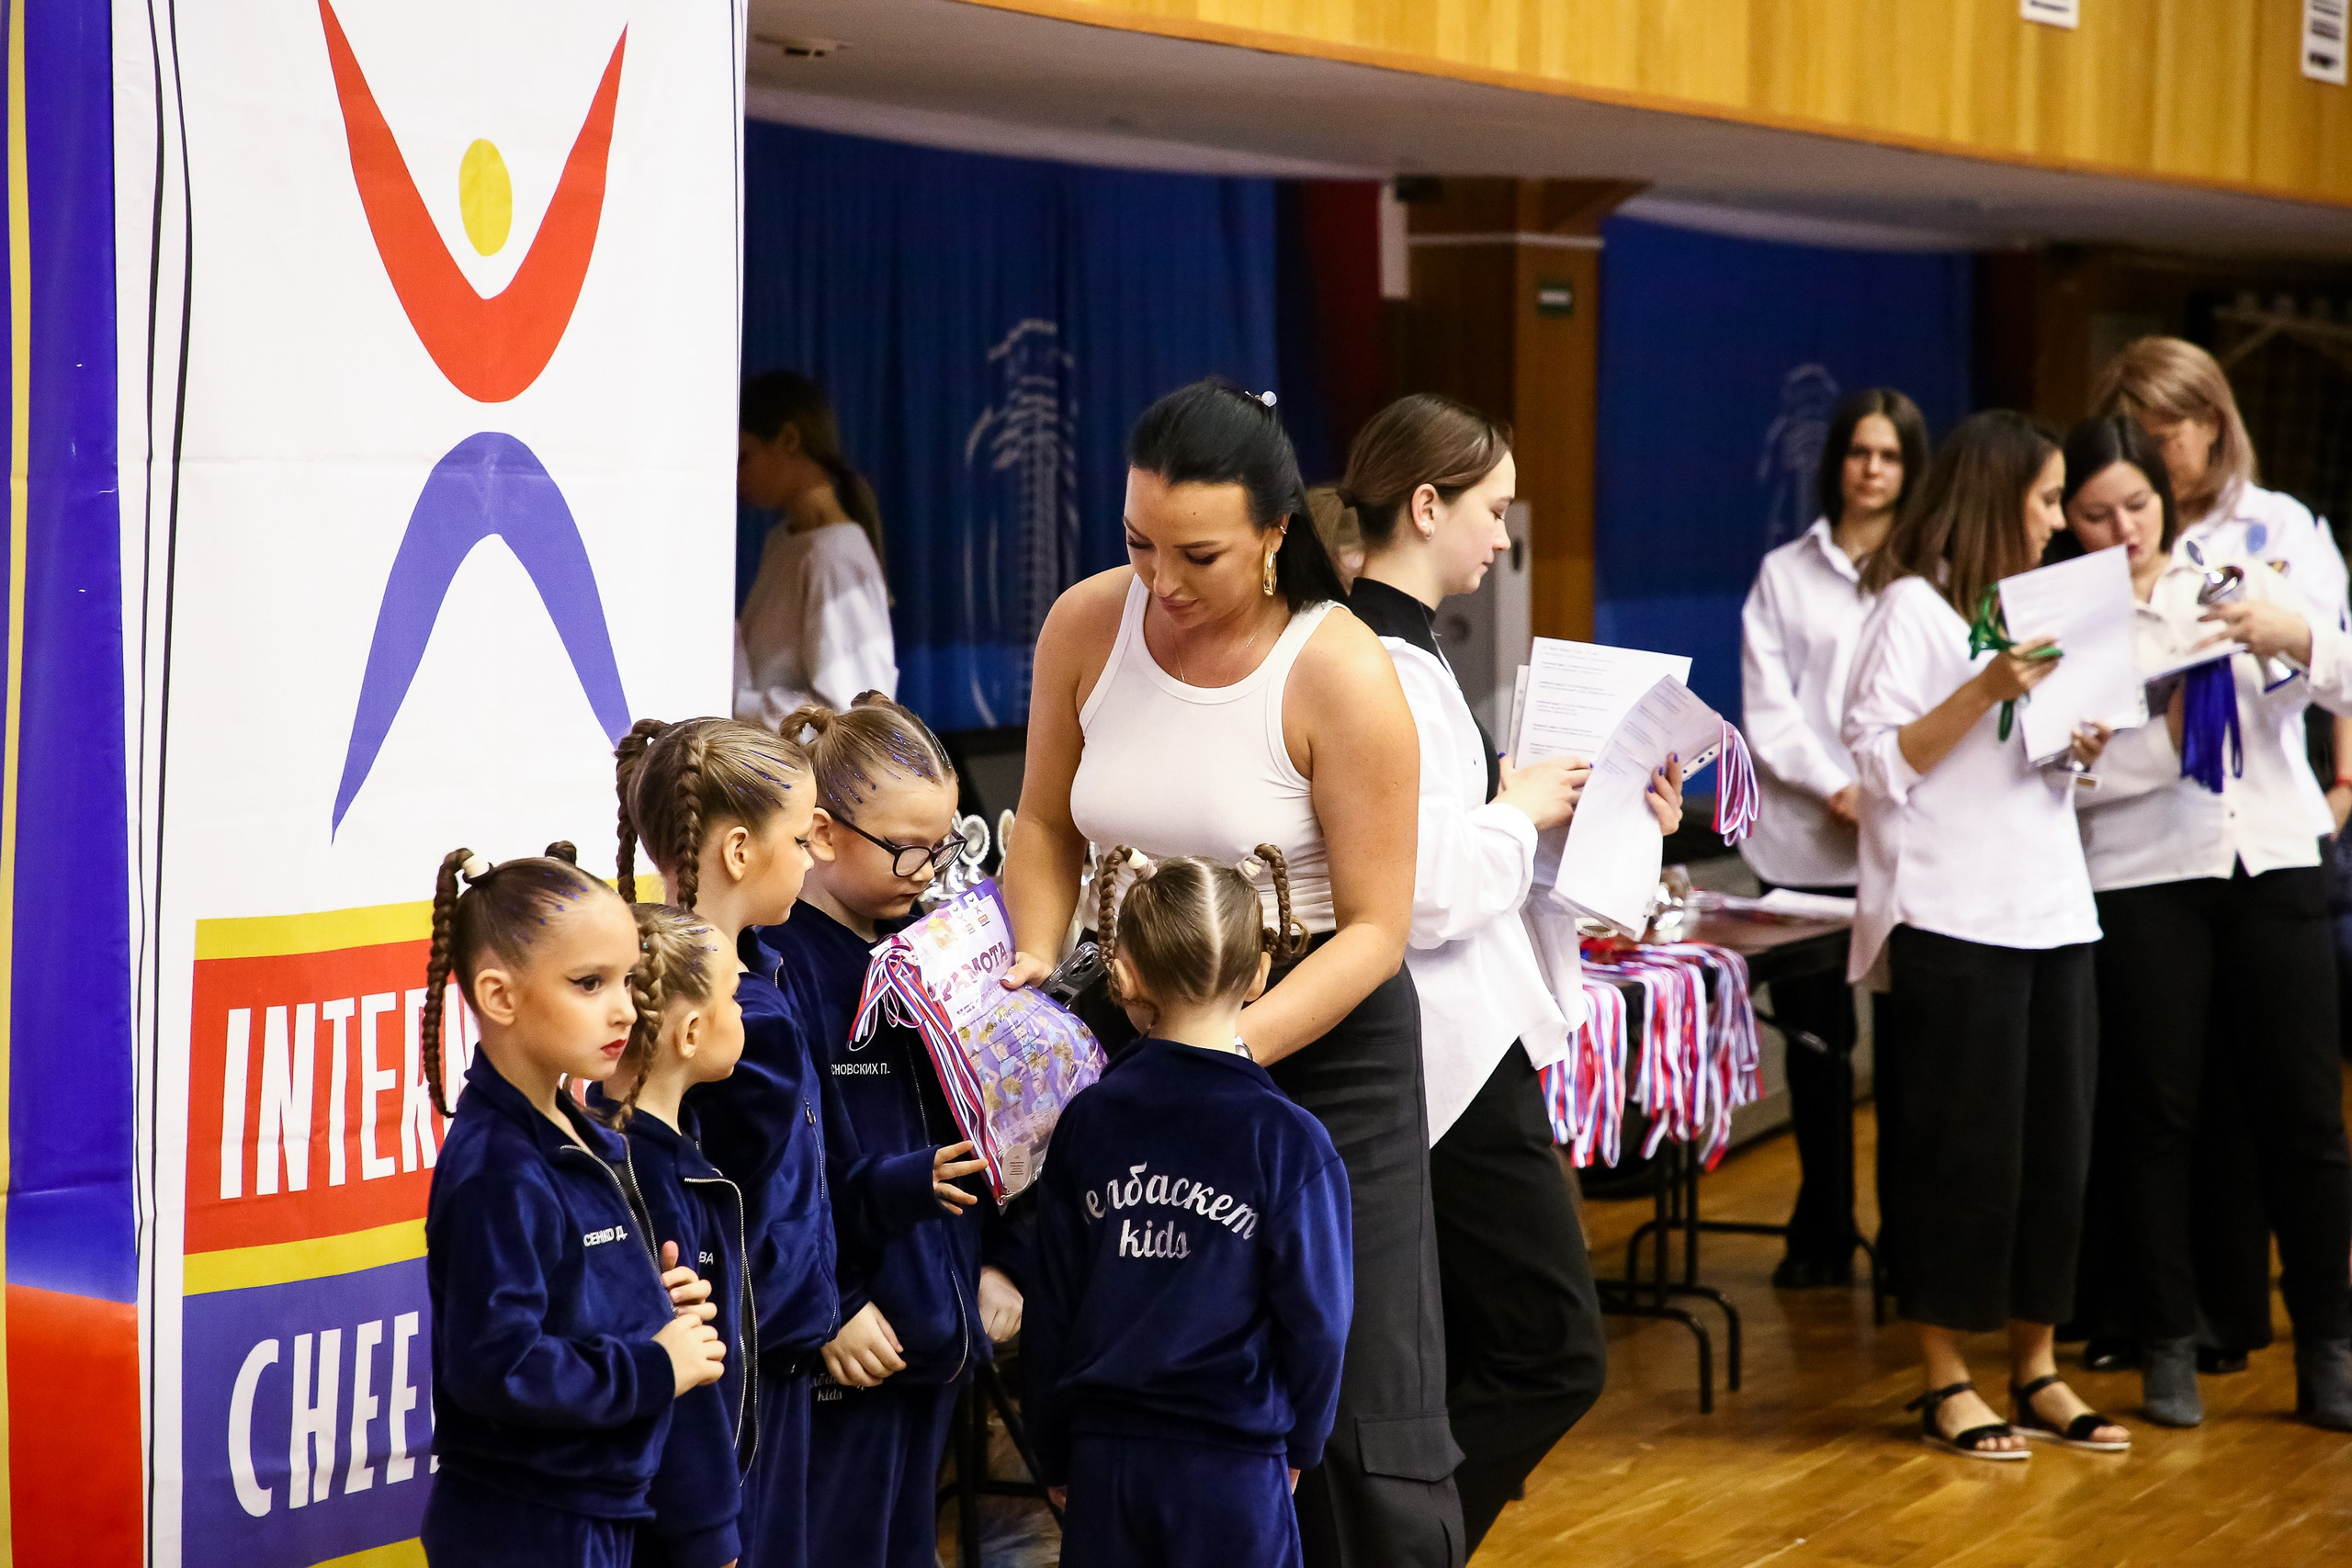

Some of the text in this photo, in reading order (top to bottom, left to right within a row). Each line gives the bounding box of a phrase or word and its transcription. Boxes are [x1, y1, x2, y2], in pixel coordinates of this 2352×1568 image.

[1119, 1219, 1191, 1259] kids
[227, 1311, 440, 1518] CHEE
[817, 1388, 843, 1403] kids
